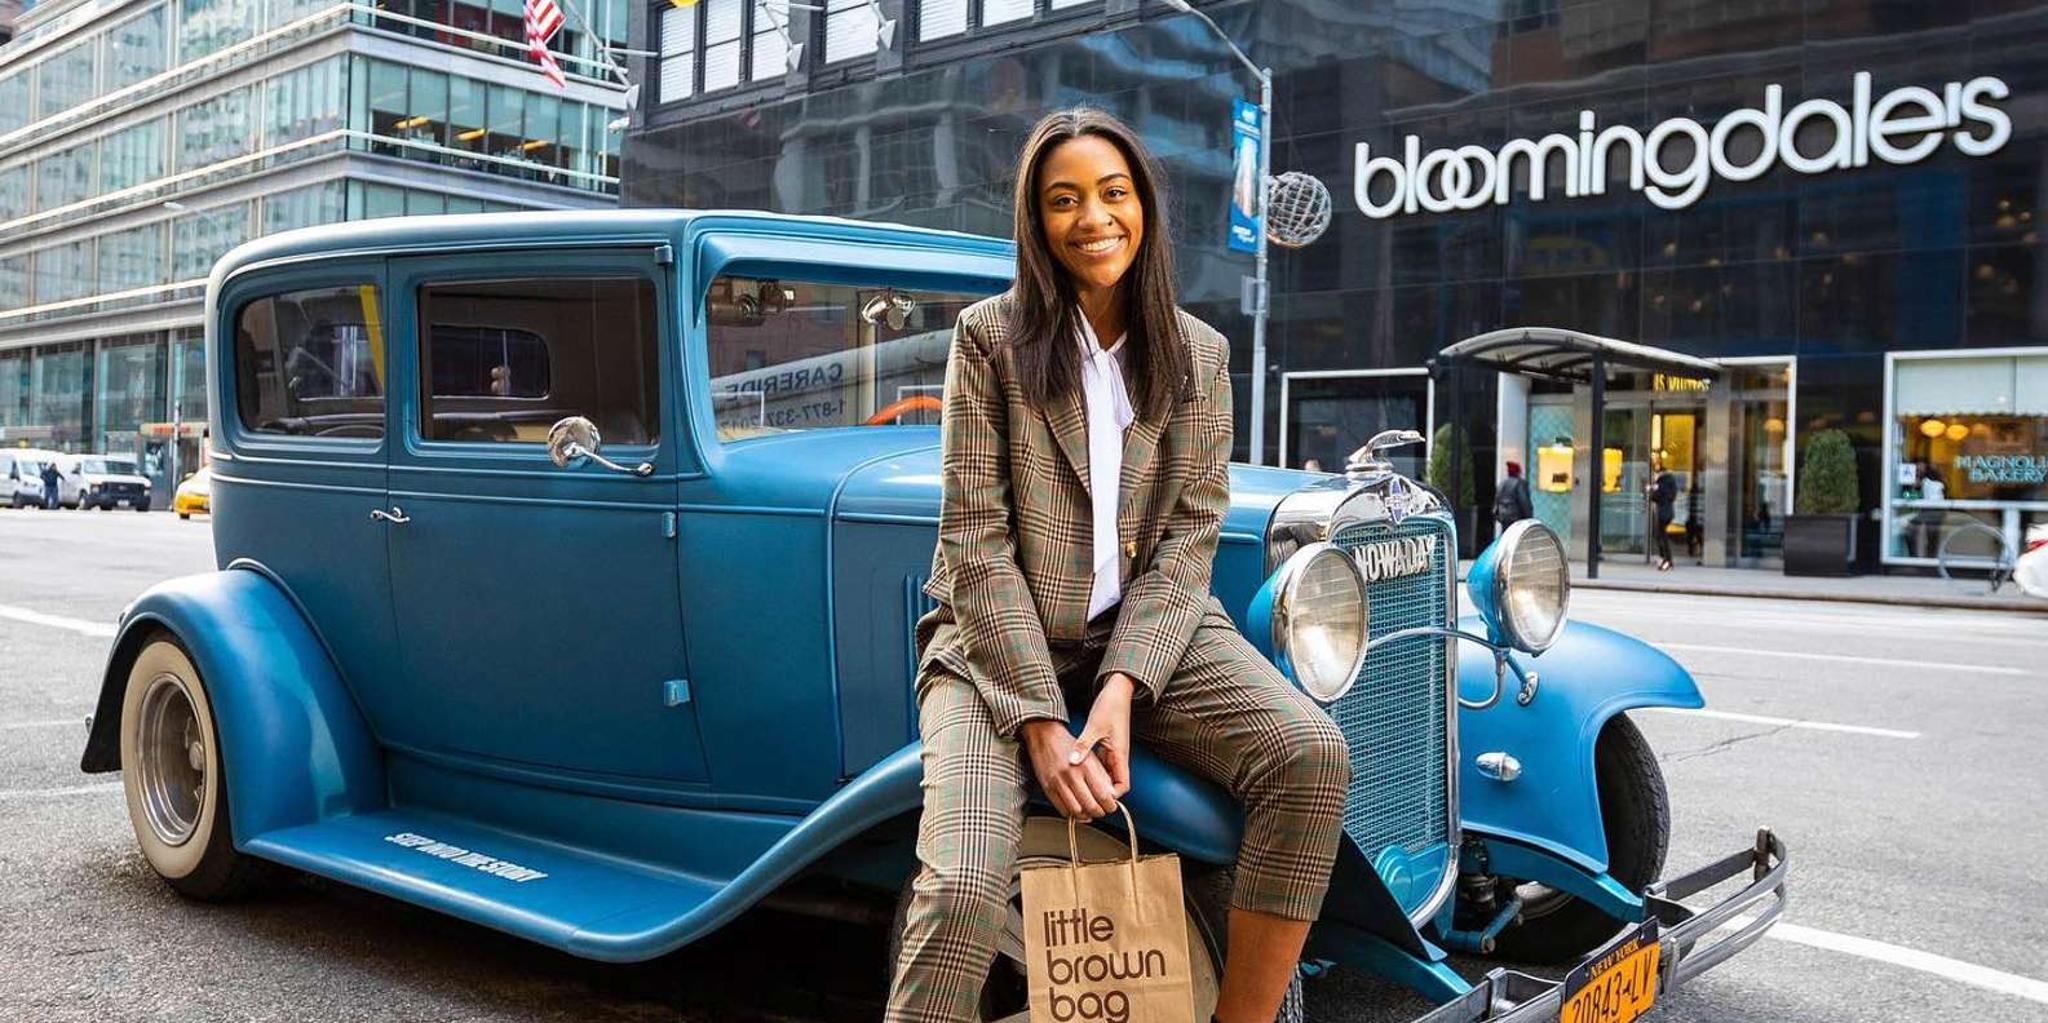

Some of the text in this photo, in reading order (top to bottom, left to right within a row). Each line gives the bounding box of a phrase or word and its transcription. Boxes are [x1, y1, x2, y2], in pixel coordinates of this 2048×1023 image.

[1969, 468, 2047, 482] BAKERY
[1354, 534, 1437, 582] NOWADAY
[1043, 908, 1114, 947] little
[1046, 948, 1167, 985] brown
[1049, 986, 1130, 1023] bag
